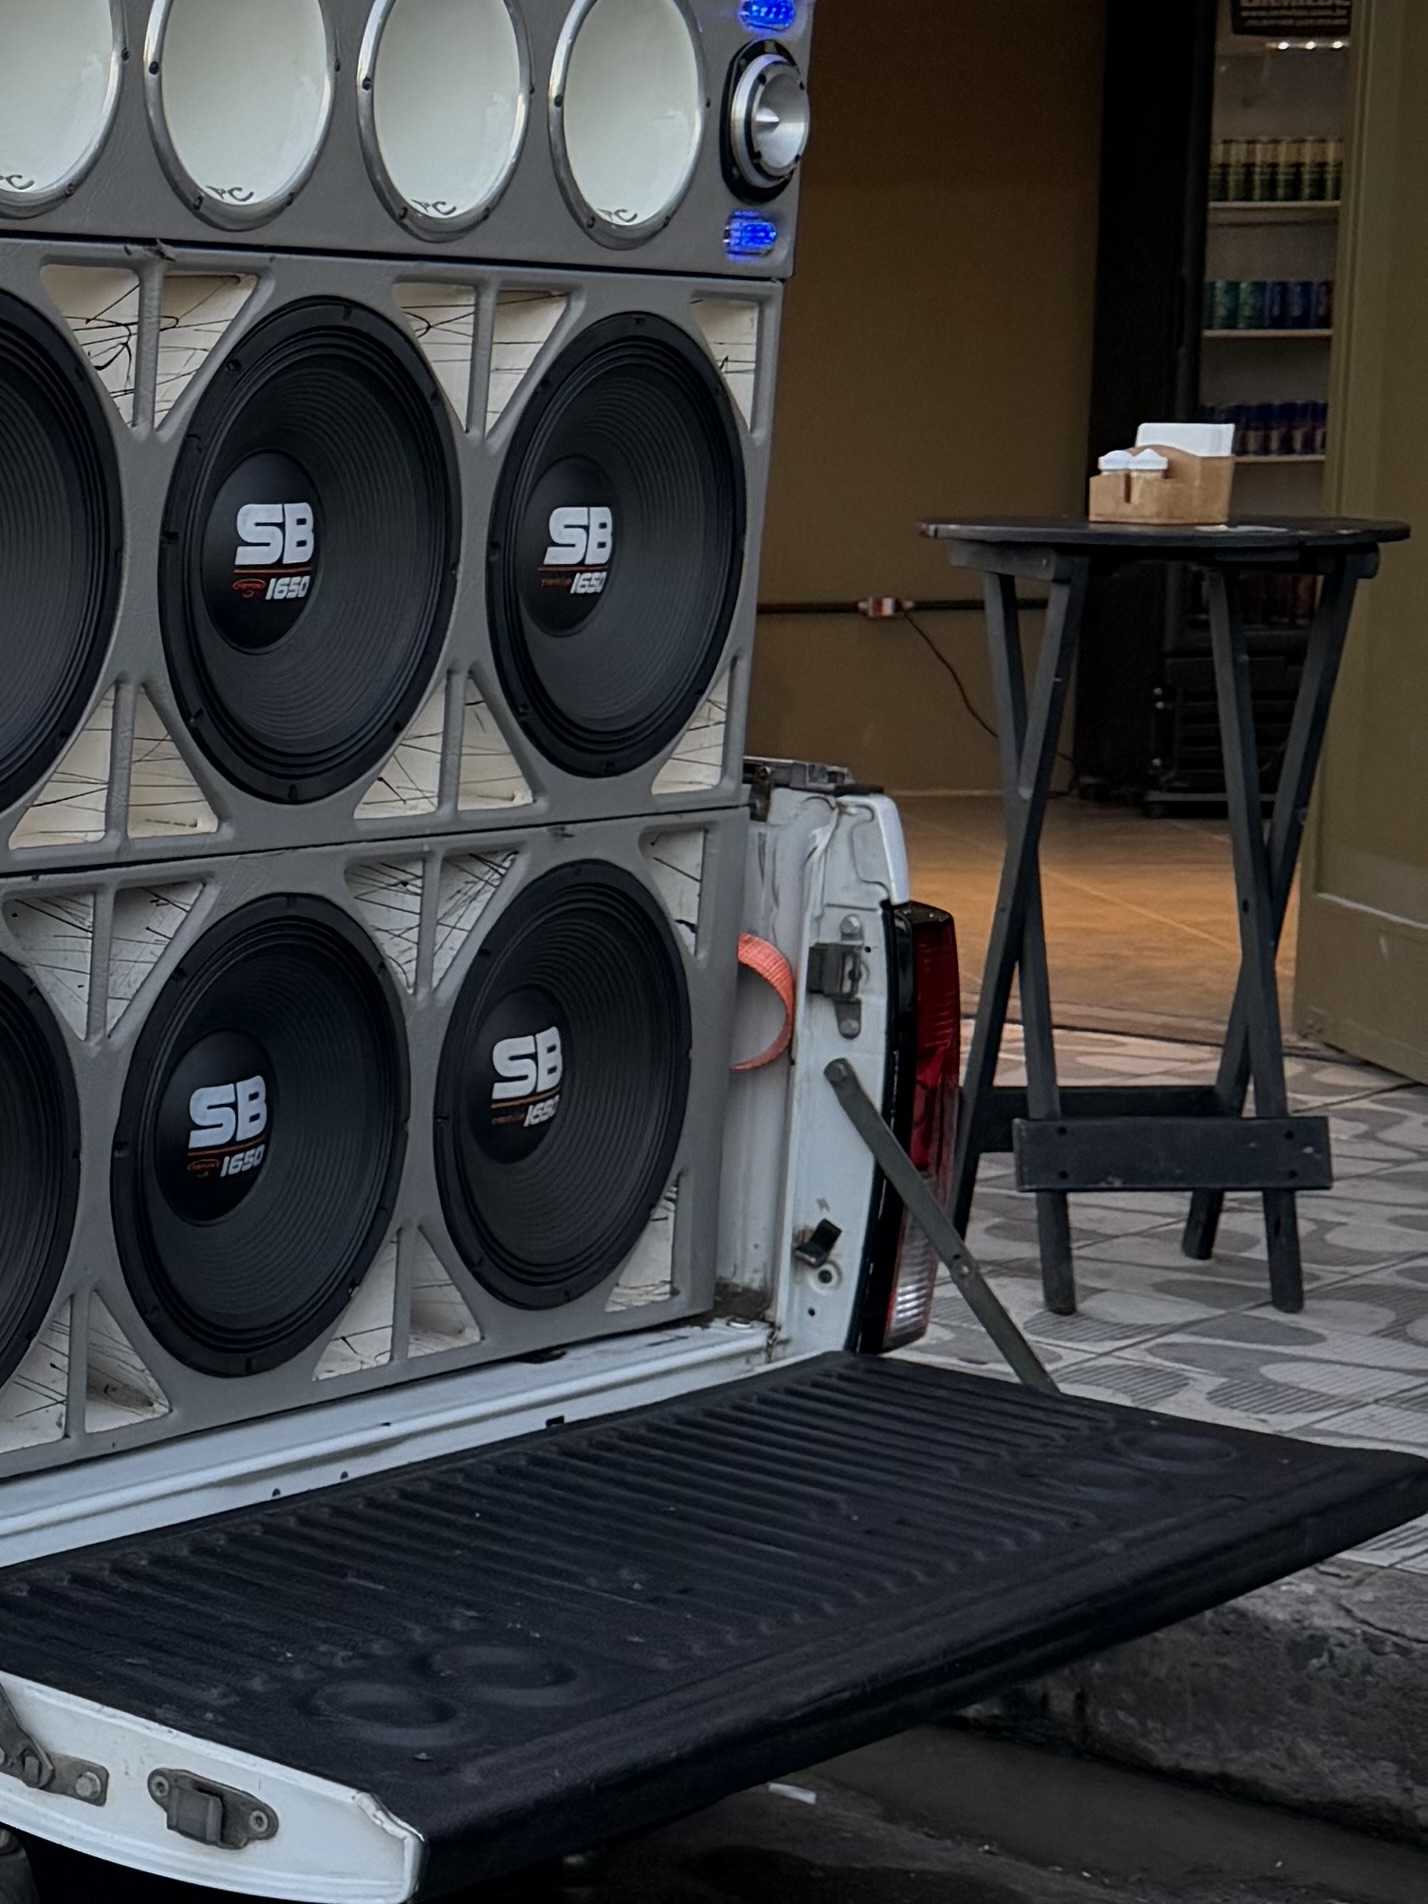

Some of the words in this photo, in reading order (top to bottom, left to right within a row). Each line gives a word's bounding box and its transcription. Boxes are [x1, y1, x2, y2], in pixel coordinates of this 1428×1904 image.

[235, 502, 314, 565] SB
[544, 506, 613, 565] SB
[265, 575, 310, 600] 1650
[492, 1026, 563, 1100] SB
[188, 1075, 267, 1149] SB
[220, 1144, 265, 1177] 1650
